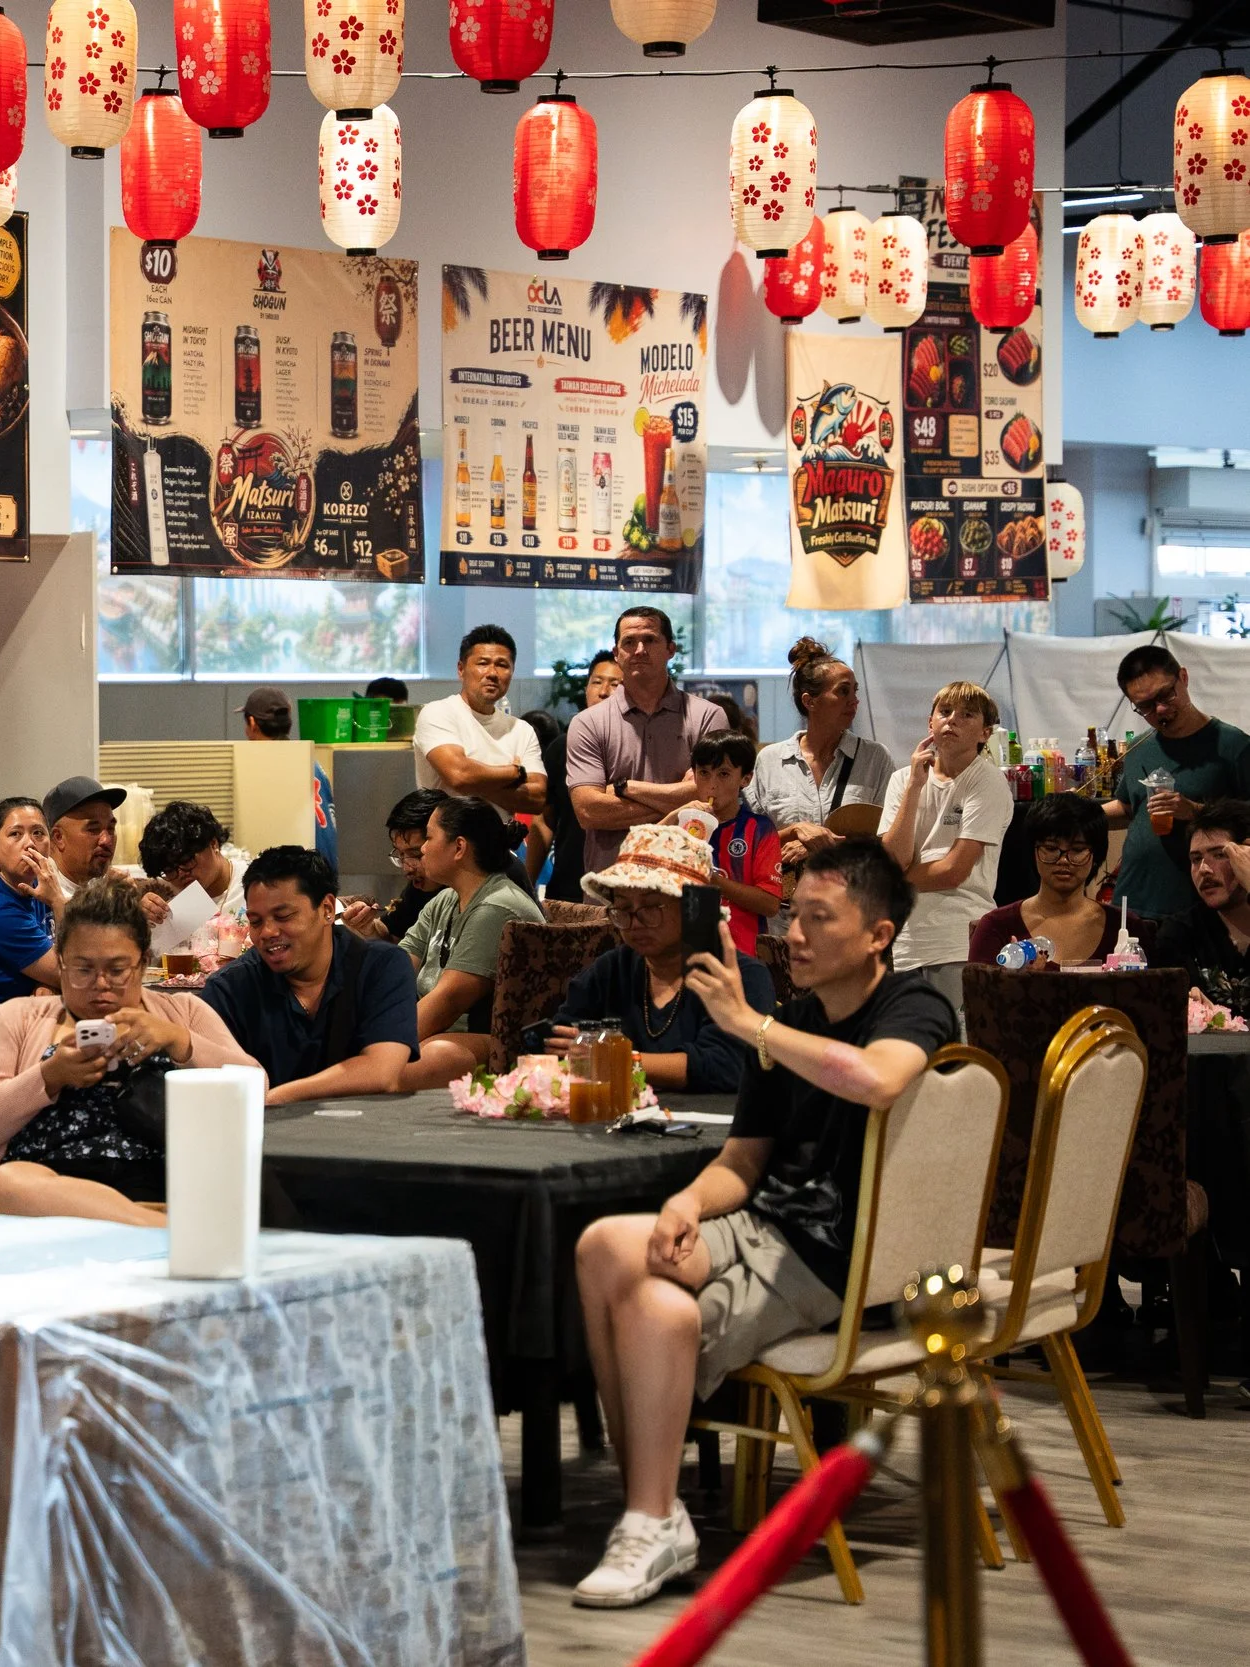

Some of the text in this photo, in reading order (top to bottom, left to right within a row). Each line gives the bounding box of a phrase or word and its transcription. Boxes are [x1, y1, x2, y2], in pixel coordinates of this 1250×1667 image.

[145, 249, 172, 277] $10
[942, 255, 966, 268] EVENT
[151, 285, 168, 294] EACH
[159, 296, 173, 305] CAN
[183, 326, 209, 335] MIDNIGHT
[190, 337, 207, 346] TOKYO
[276, 336, 292, 344] DUSK
[490, 318, 591, 362] BEER MENU
[640, 343, 693, 375] MODELO
[983, 363, 998, 377] $20
[458, 371, 522, 386] INTERNATIONAL FAVORITES
[639, 371, 700, 404] Michelada
[678, 407, 694, 428] $15
[914, 416, 936, 438] $48
[985, 450, 1000, 466] $35
[803, 461, 883, 504] Maguro
[223, 472, 296, 519] Matsuri
[324, 503, 368, 517] KOREZO
[812, 496, 879, 529] Matsuri
[911, 501, 950, 511] MATSURI BOWL
[247, 511, 282, 520] IZAKAYA
[314, 538, 328, 556] $6
[811, 531, 834, 547] Freshly
[835, 533, 844, 543] Cut
[353, 540, 373, 557] $12
[964, 558, 974, 569] $7
